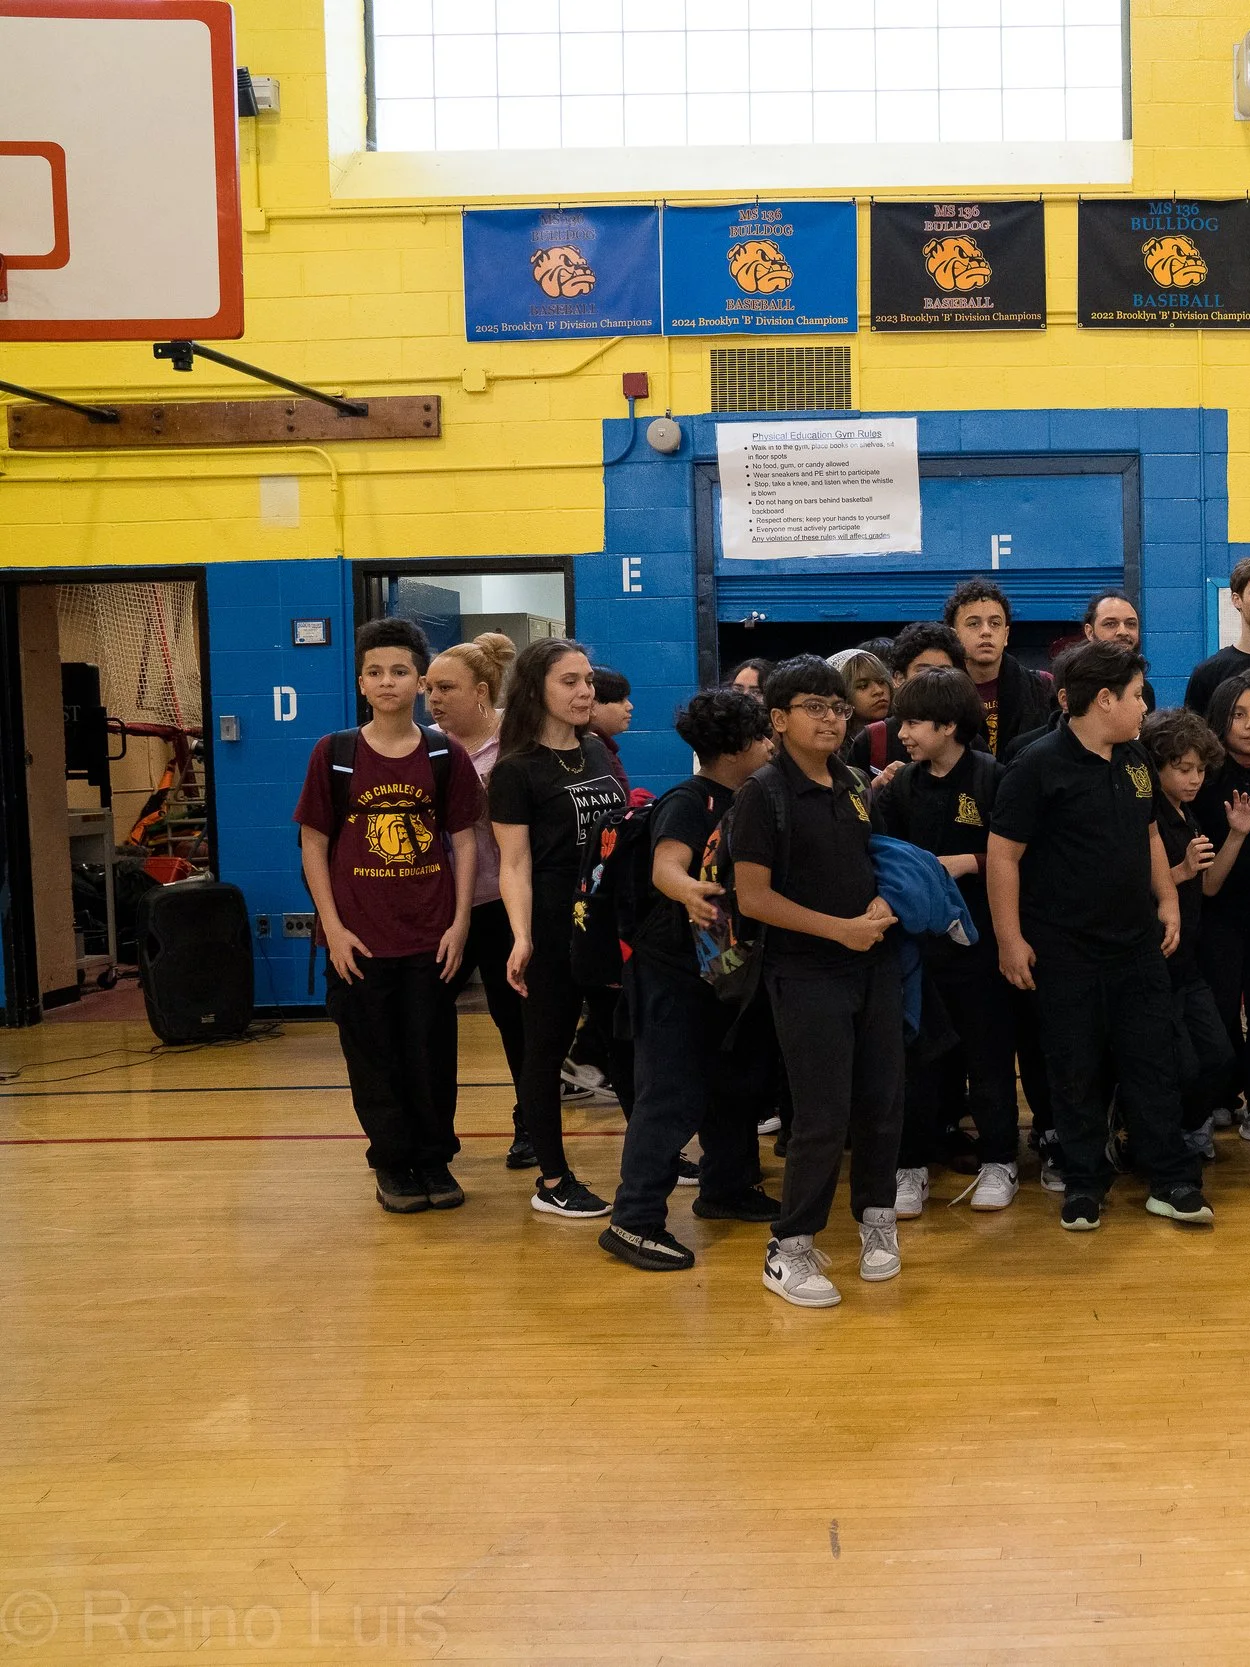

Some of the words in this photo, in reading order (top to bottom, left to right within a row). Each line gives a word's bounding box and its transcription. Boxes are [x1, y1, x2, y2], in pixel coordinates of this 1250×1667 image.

[738, 210, 758, 222] MS
[761, 209, 782, 221] 136
[935, 205, 955, 217] MS
[958, 206, 980, 219] 136
[1150, 203, 1174, 215] MS
[1177, 203, 1199, 216] 136
[540, 214, 562, 225] MS
[564, 214, 584, 225] 136
[924, 220, 991, 232] BULLDOG
[1131, 218, 1218, 232] BULLDOG
[531, 229, 596, 241] BULLDOG
[729, 225, 793, 237] BULLDOG
[726, 299, 794, 311] BASEBALL
[924, 297, 993, 310] BASEBALL
[1133, 294, 1224, 308] BASEBALL
[530, 303, 597, 315] BASEBALL
[698, 316, 739, 327] Brooklyn
[742, 316, 753, 324] 'B'
[756, 316, 794, 325] Division
[796, 316, 848, 327] Champions
[876, 316, 897, 324] 2023
[900, 314, 939, 324] Brooklyn
[955, 313, 990, 321] Division
[992, 312, 1041, 322] Champions
[1116, 311, 1156, 321] Brooklyn
[1159, 311, 1170, 319] 'B'
[501, 322, 543, 332] Brooklyn
[560, 321, 597, 329] Division
[600, 318, 652, 329] Champions
[753, 432, 787, 440] Physical
[790, 431, 832, 440] Education
[835, 430, 854, 439] Gym
[858, 430, 882, 438] Rules
[848, 469, 880, 477] participate
[991, 534, 1011, 569] F
[623, 558, 642, 592] E
[273, 686, 298, 722] D
[358, 791, 373, 805] 136
[374, 784, 415, 796] CHARLES
[354, 867, 396, 877] PHYSICAL
[400, 864, 440, 877] EDUCATION
